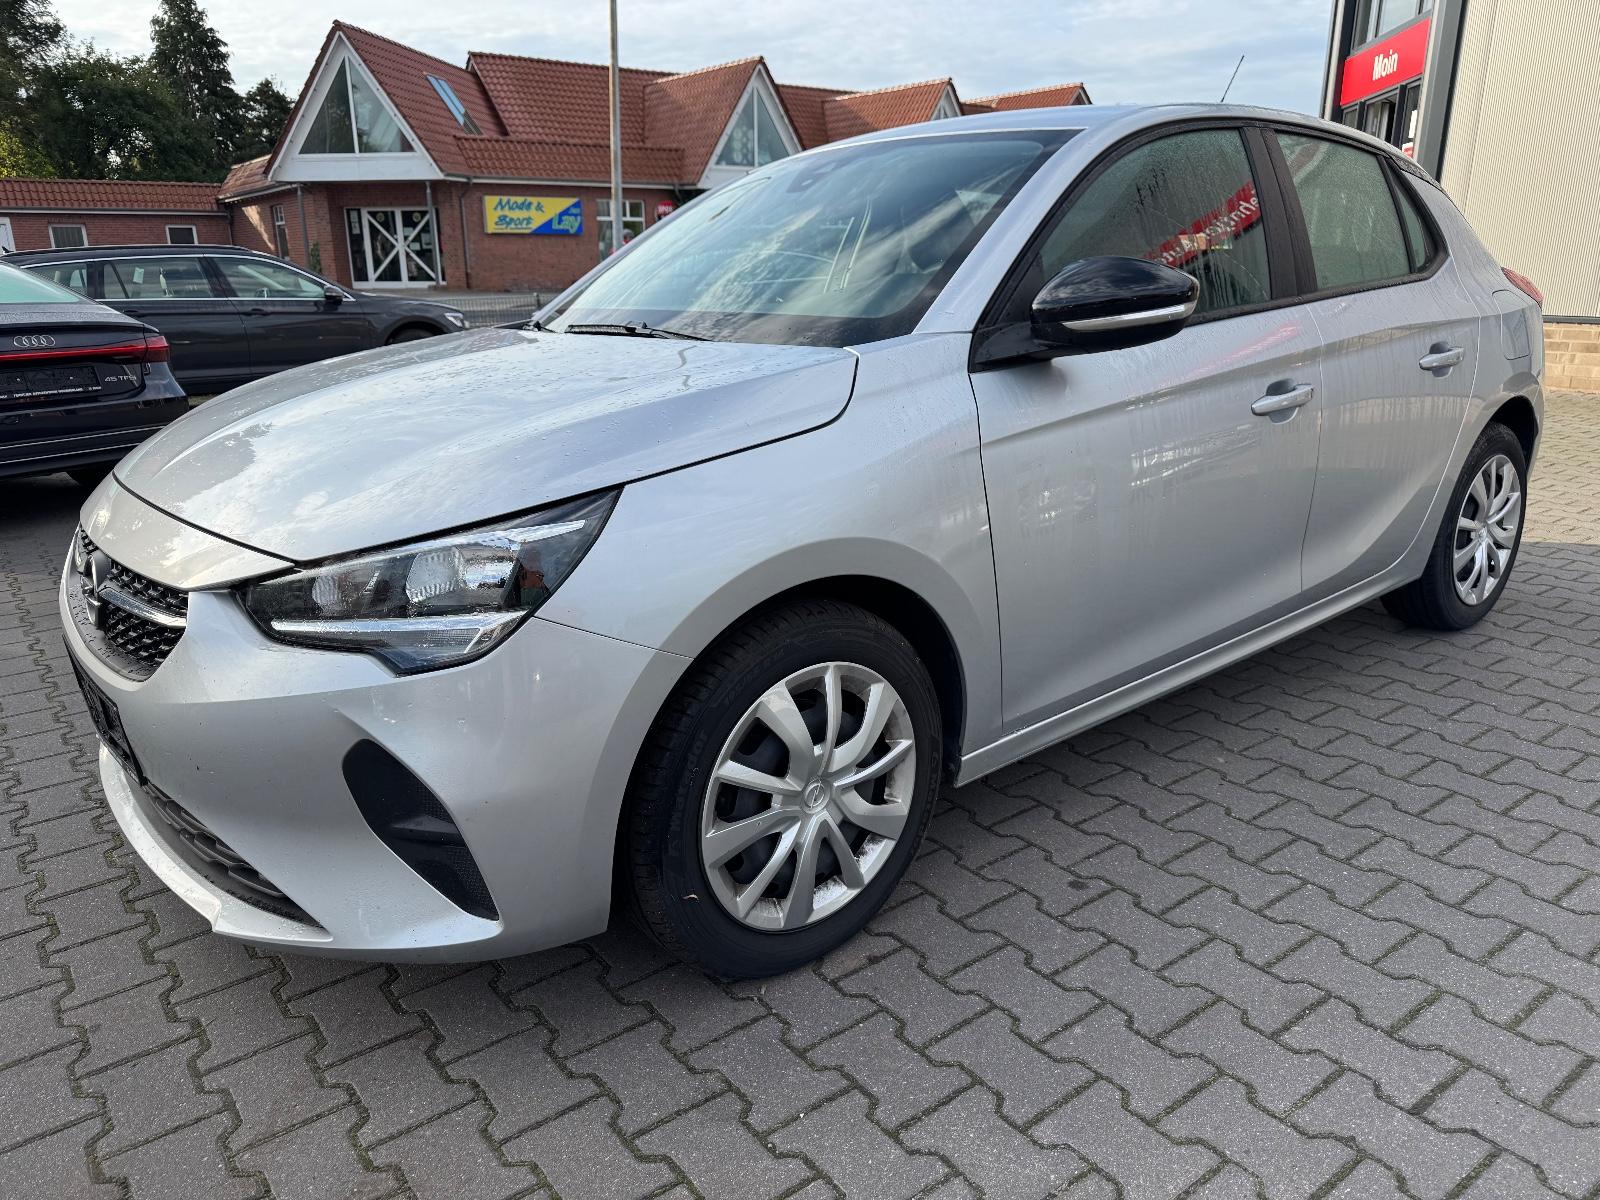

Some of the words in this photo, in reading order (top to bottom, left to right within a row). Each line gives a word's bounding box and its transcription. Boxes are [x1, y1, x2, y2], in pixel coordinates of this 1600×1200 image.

[1372, 49, 1398, 80] Moin
[494, 198, 532, 212] Mode
[535, 201, 545, 213] &
[494, 214, 533, 229] Sport
[552, 213, 580, 234] Lay
